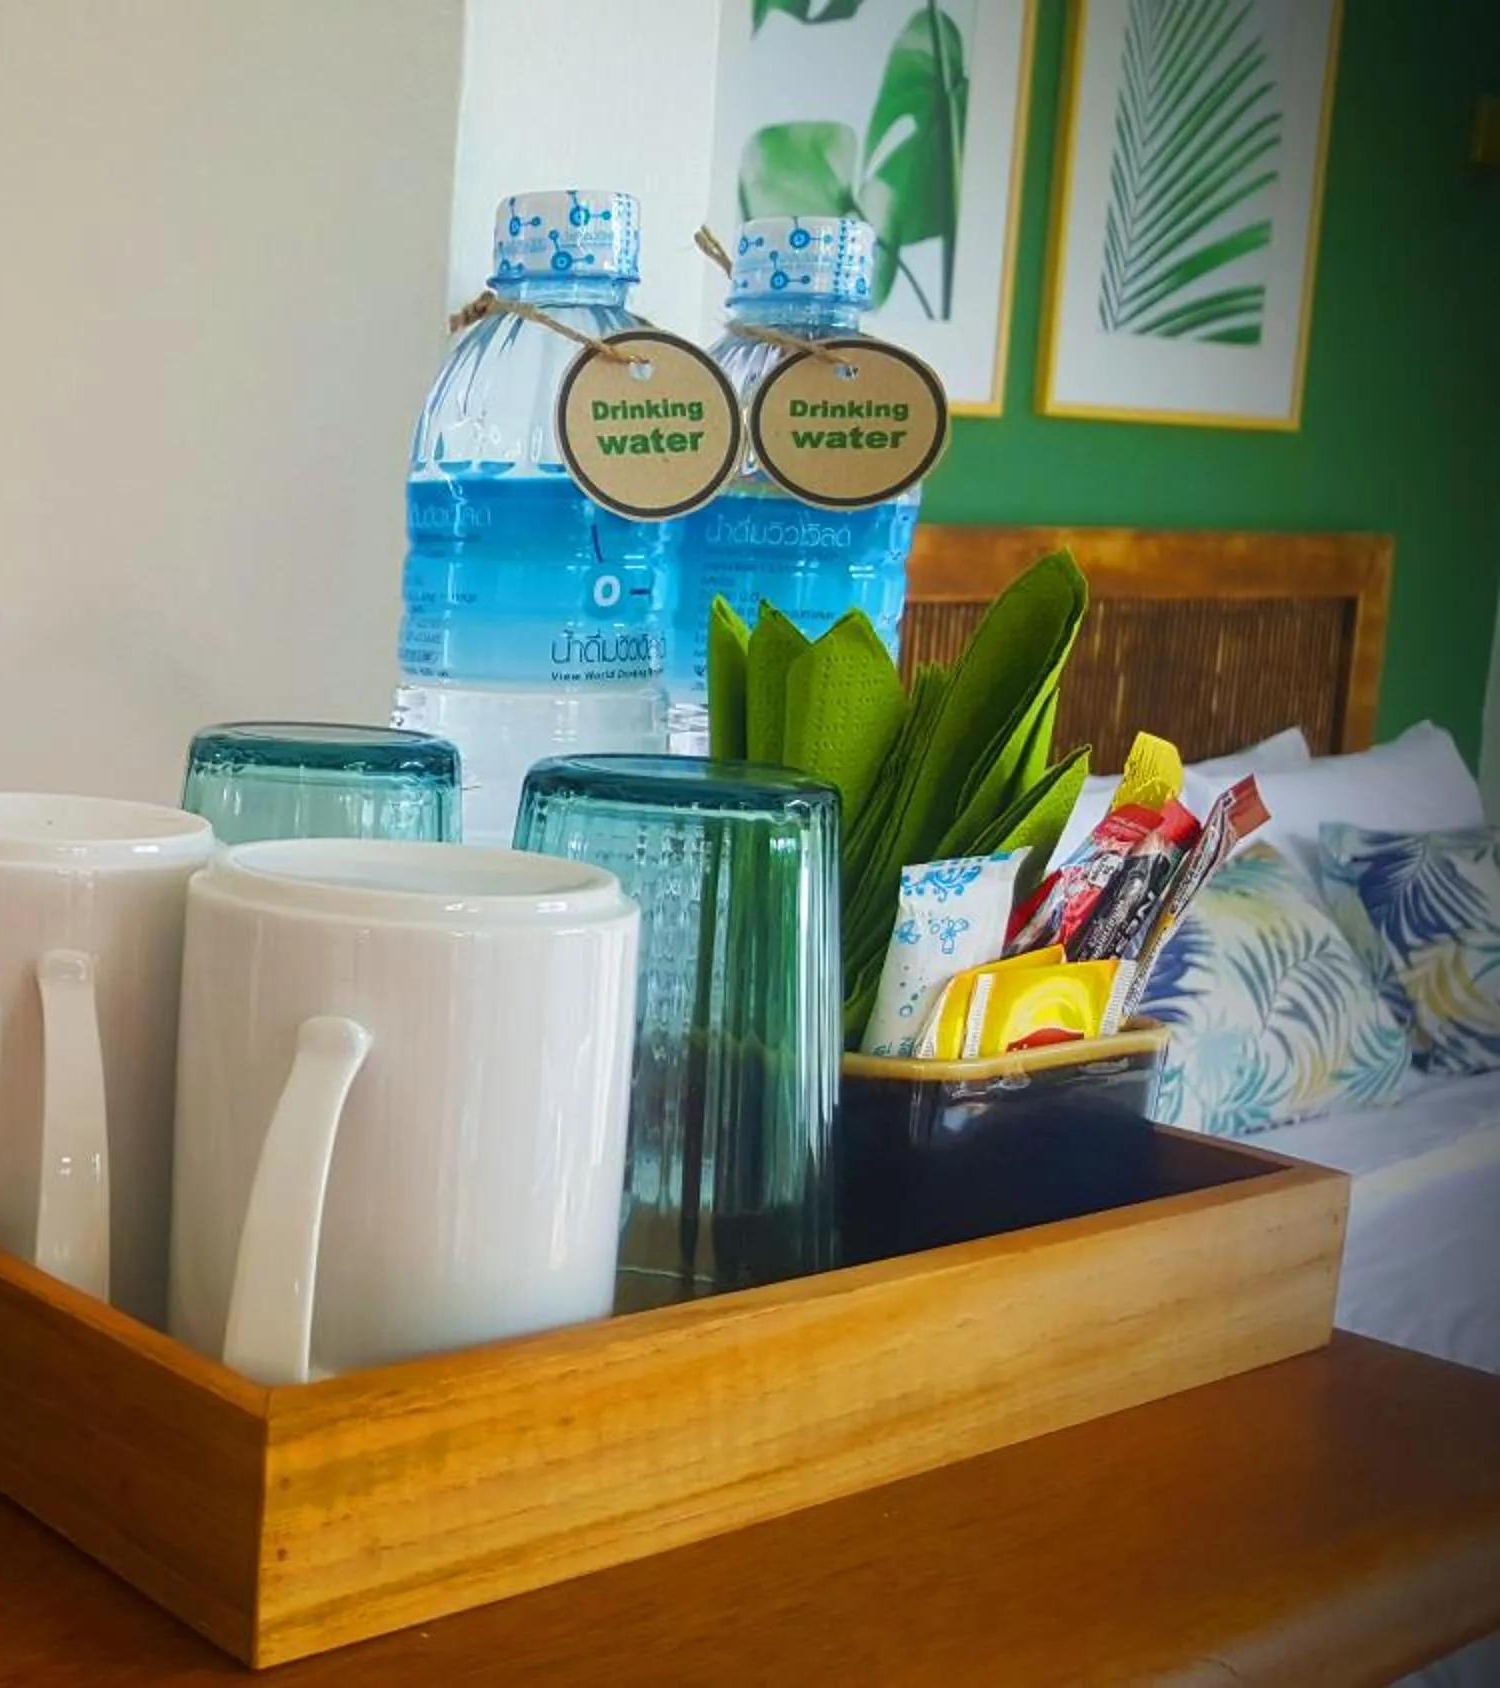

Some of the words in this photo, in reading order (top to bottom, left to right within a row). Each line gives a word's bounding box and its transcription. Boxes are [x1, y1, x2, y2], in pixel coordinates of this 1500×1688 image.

[591, 399, 704, 422] Drinking
[789, 399, 909, 420] Drinking
[596, 429, 705, 456] water
[791, 427, 907, 450] water
